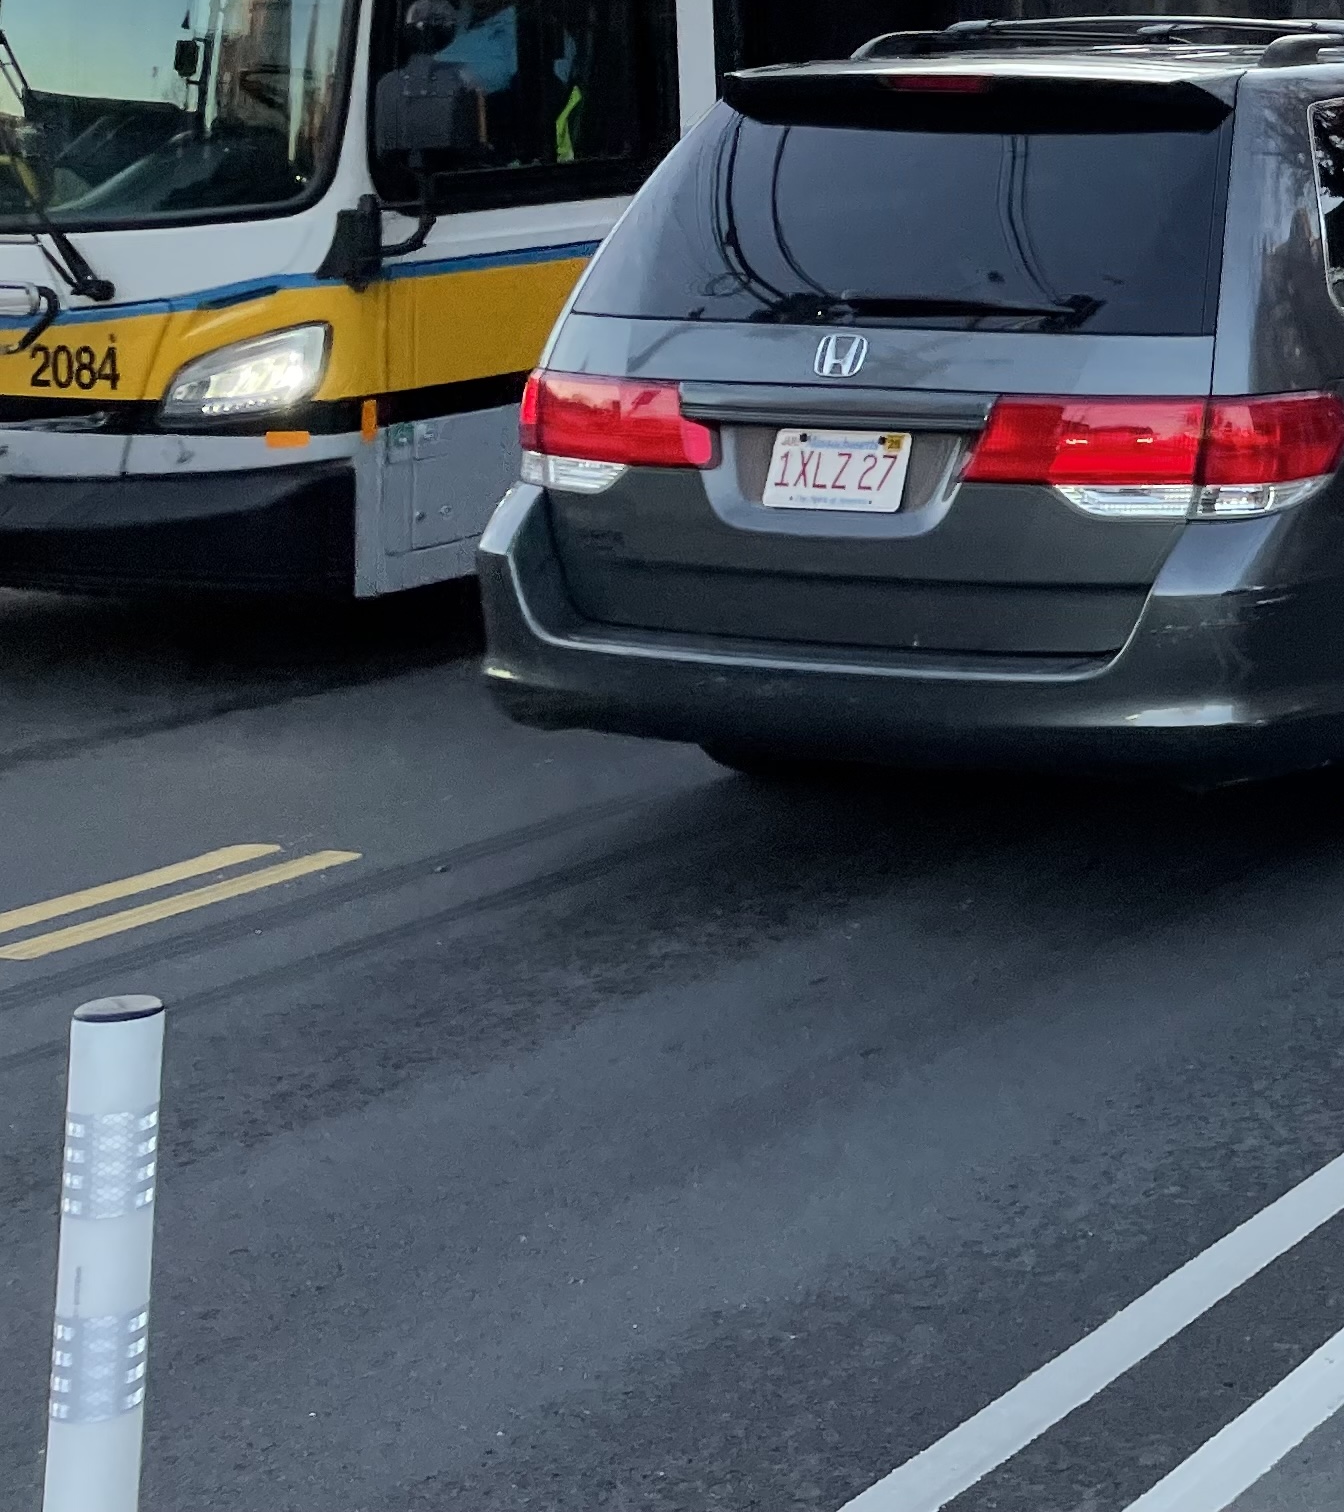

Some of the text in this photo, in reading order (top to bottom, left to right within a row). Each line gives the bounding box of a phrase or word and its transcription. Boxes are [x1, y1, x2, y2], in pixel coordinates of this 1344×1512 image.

[30, 344, 120, 390] 2084
[774, 450, 898, 491] 1XLZ 27
